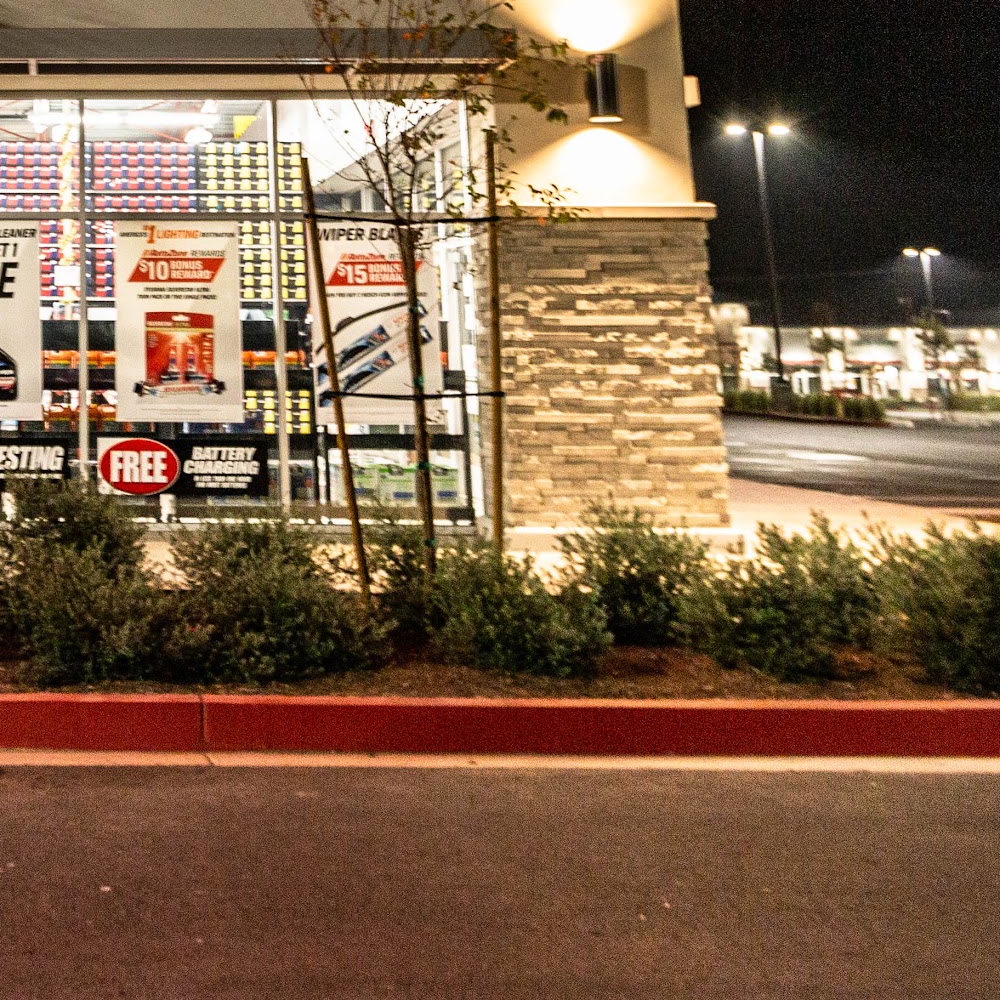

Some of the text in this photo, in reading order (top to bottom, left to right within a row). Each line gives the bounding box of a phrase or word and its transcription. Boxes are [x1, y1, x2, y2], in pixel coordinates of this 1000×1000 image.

[157, 230, 201, 239] LIGHTING
[318, 228, 424, 241] WIPER BLAS
[12, 243, 19, 258] 1
[139, 260, 169, 280] $10
[170, 260, 203, 270] BONUS
[368, 263, 401, 272] BONUS
[170, 269, 211, 279] REWARD
[336, 263, 368, 284] $15
[191, 446, 257, 461] BATTERY
[109, 450, 169, 484] FREE
[183, 460, 261, 475] CHARGING
